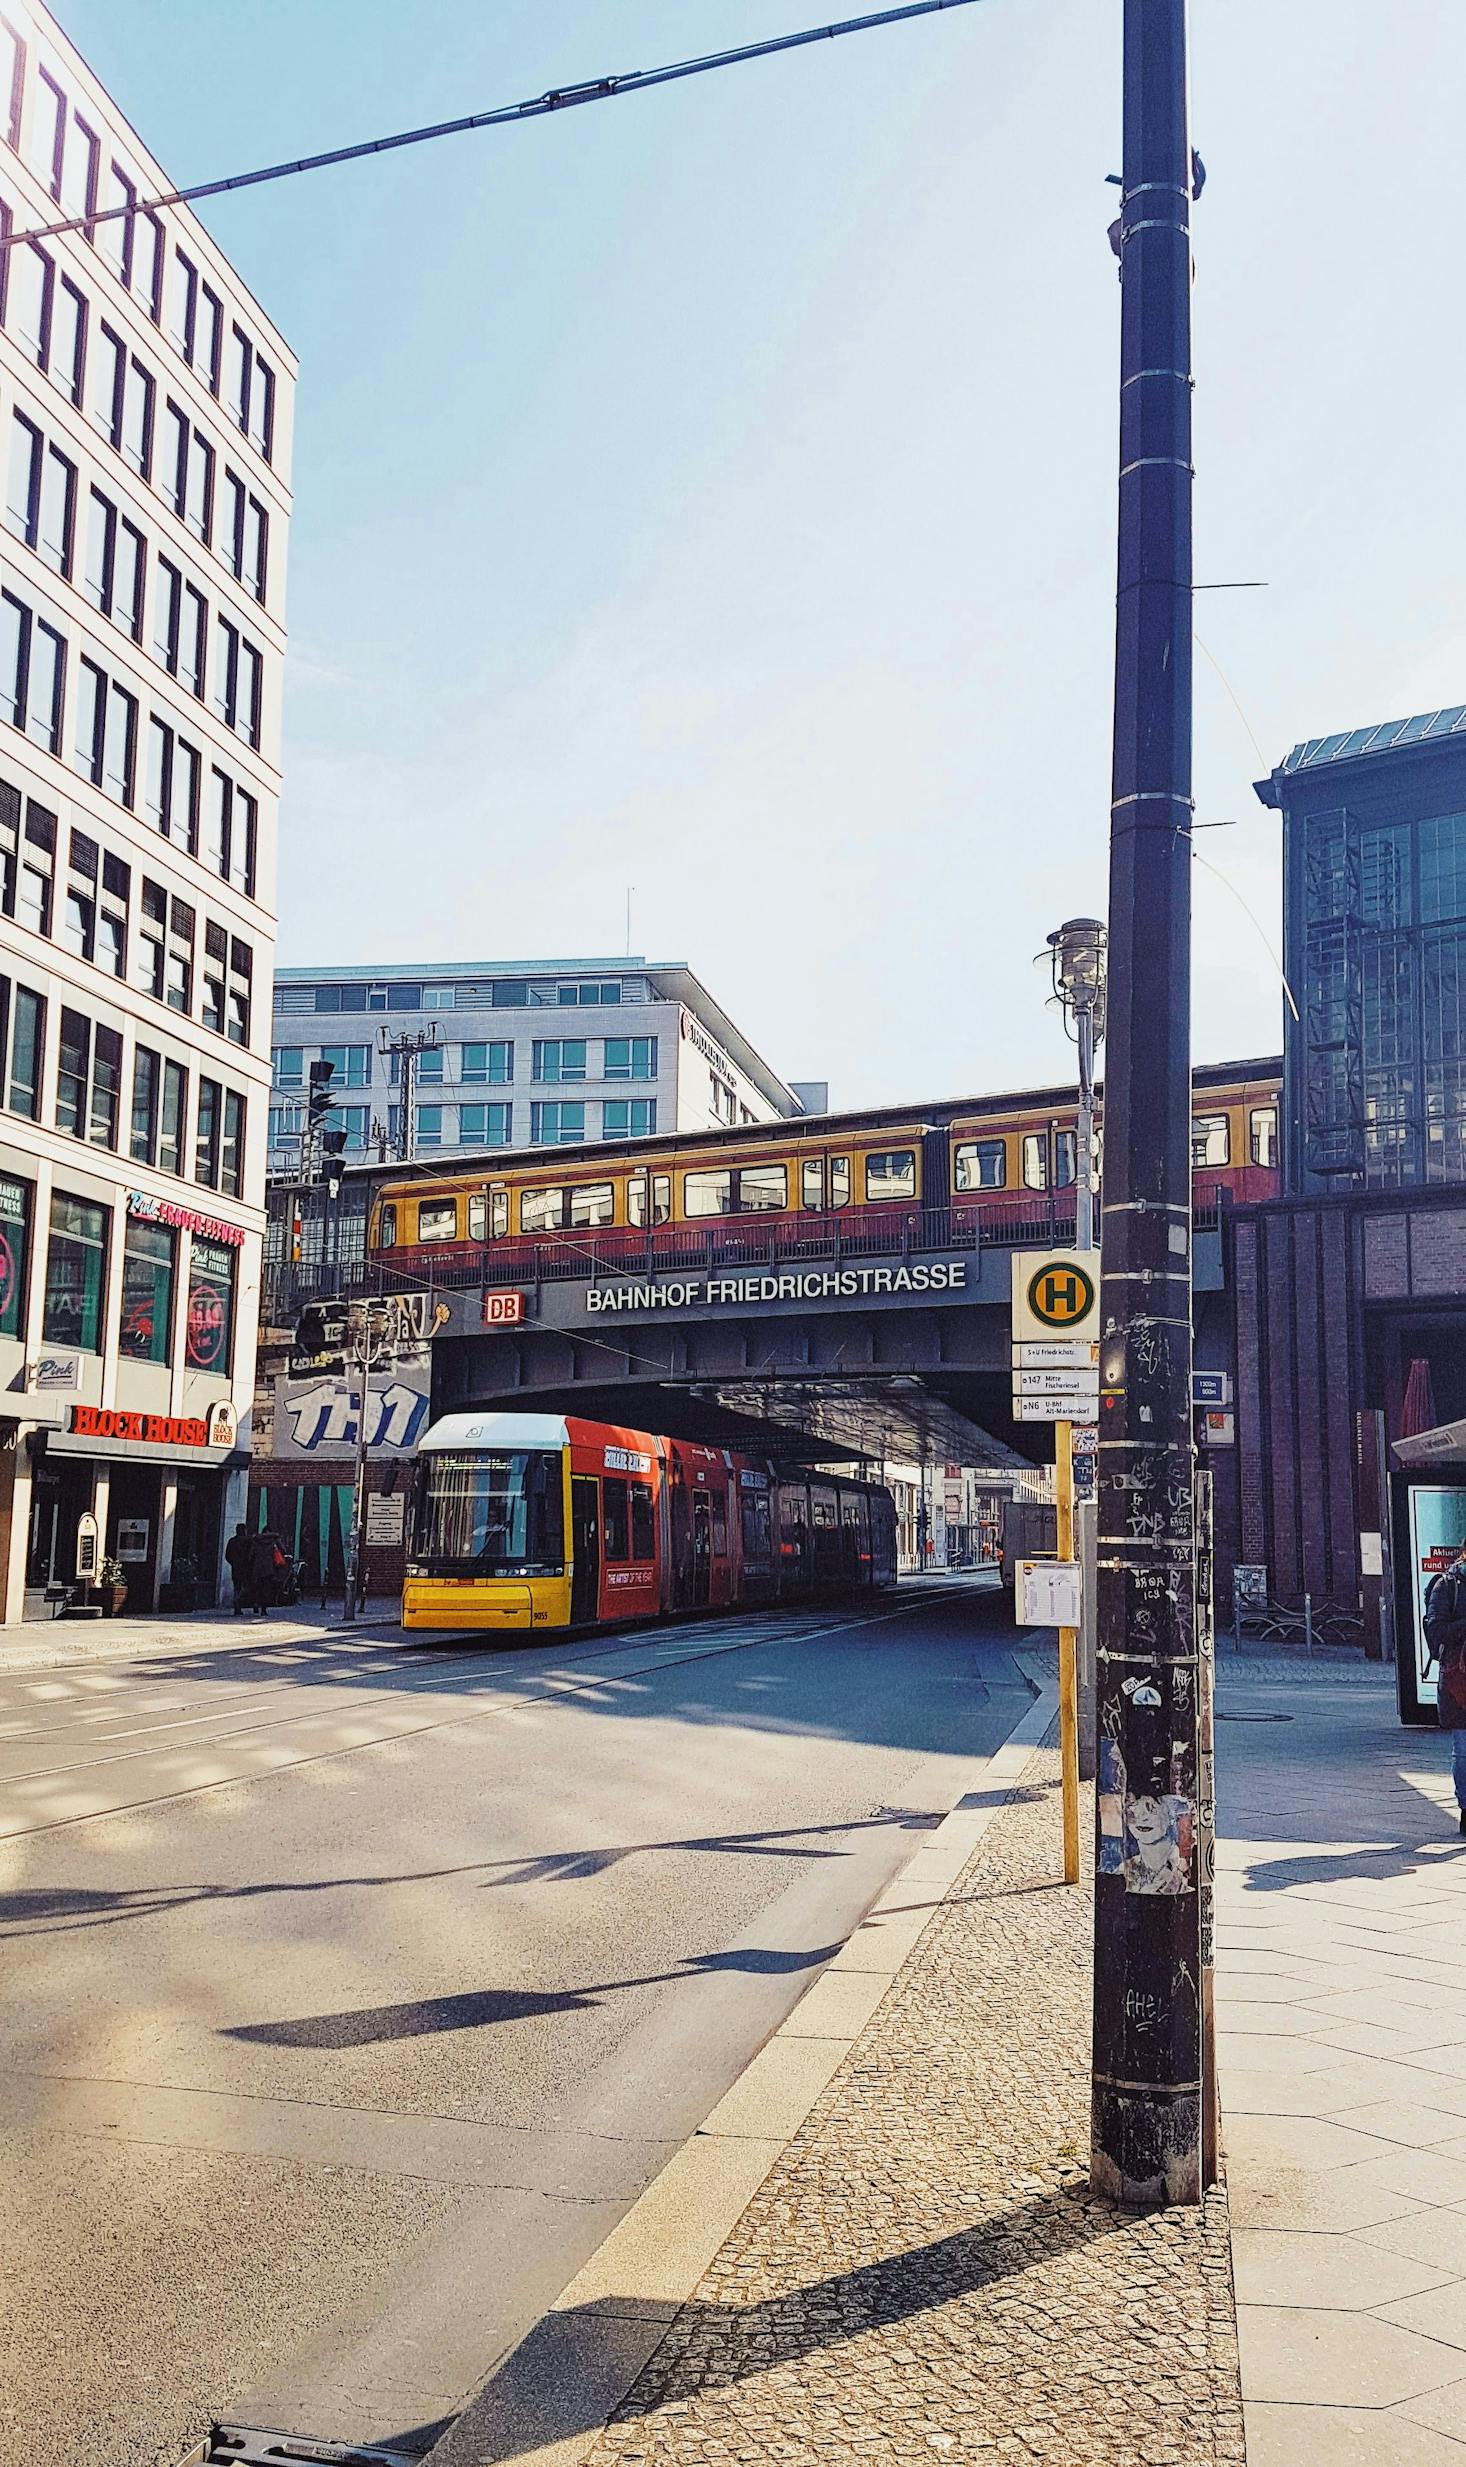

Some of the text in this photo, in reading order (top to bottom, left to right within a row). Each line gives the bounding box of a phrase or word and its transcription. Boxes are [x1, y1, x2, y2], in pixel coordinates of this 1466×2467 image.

[587, 1262, 966, 1312] BAHNHOF FRIEDRICHSTRASSE
[1045, 1277, 1077, 1313] H
[490, 1298, 516, 1319] DB
[39, 1360, 75, 1377] Pink
[1028, 1375, 1041, 1384] 147
[1028, 1401, 1040, 1410] N6
[74, 1405, 208, 1447] BLOCK HOUSE
[213, 1424, 233, 1436] BLOCK
[213, 1433, 233, 1444] HOUSE
